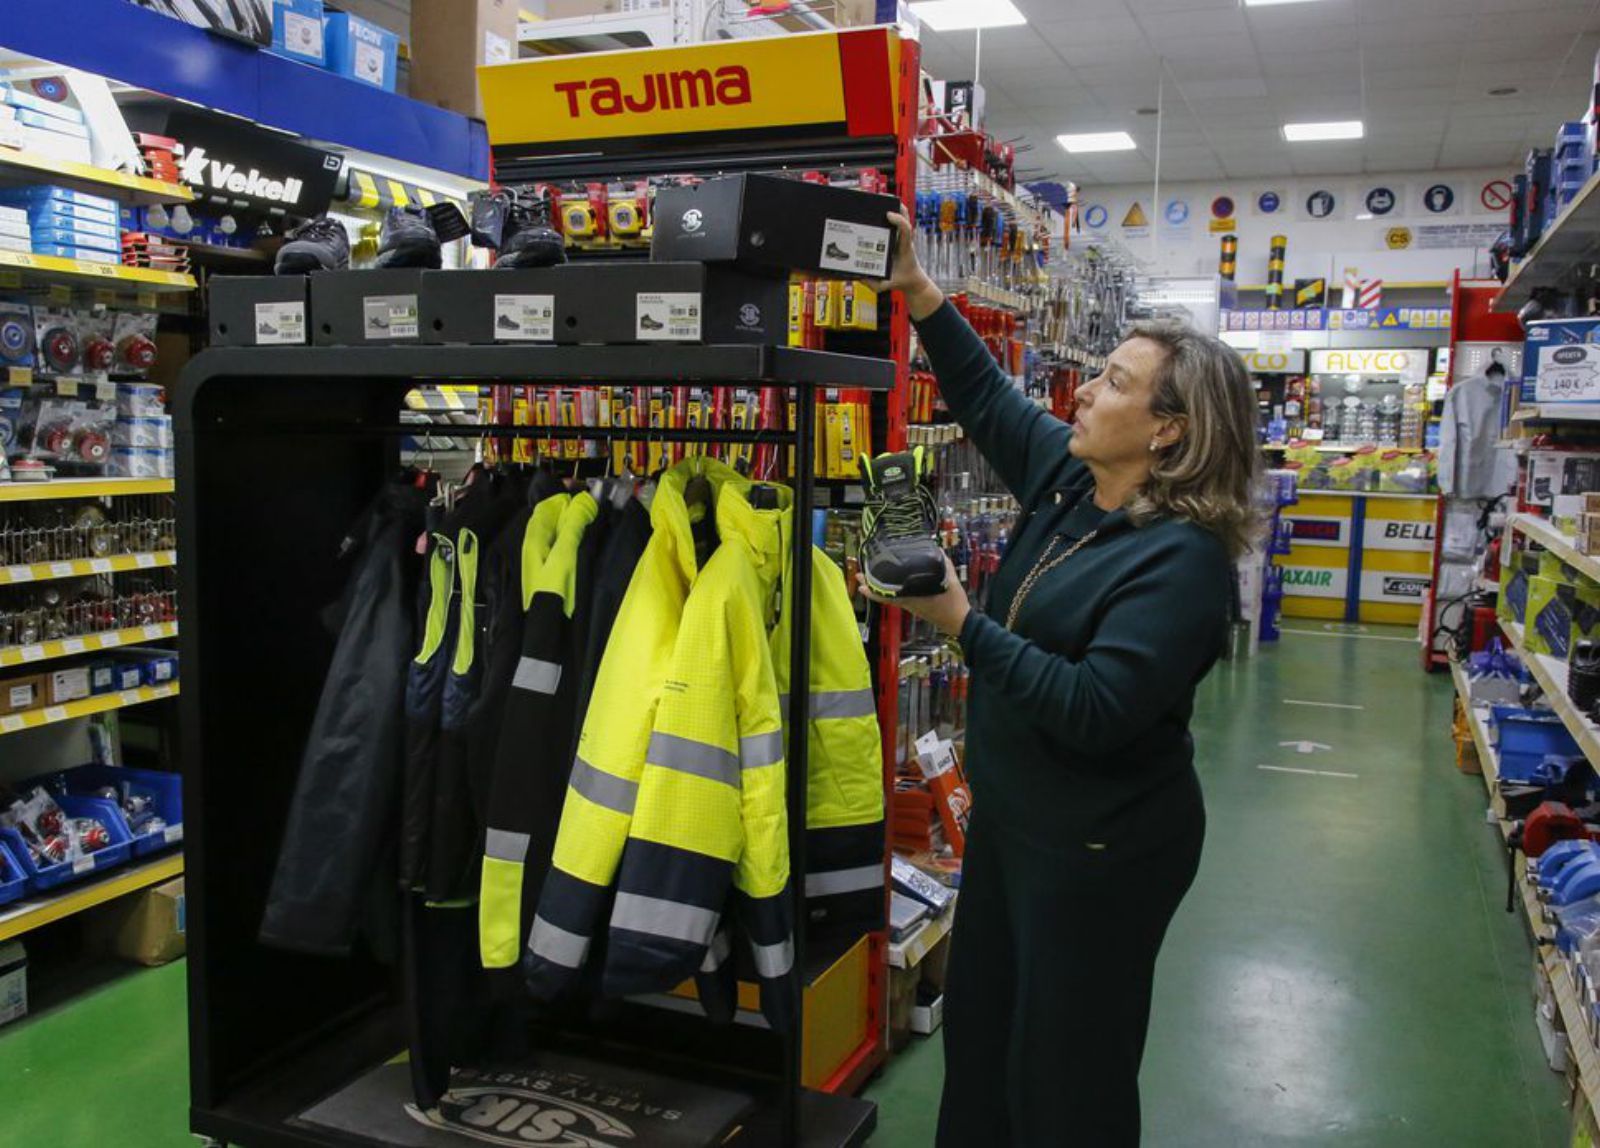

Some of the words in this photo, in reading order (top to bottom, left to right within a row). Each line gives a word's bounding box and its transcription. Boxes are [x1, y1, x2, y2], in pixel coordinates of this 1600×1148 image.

[211, 160, 303, 204] Vekell
[1327, 353, 1409, 370] ALYCO
[460, 1094, 577, 1141] SIR
